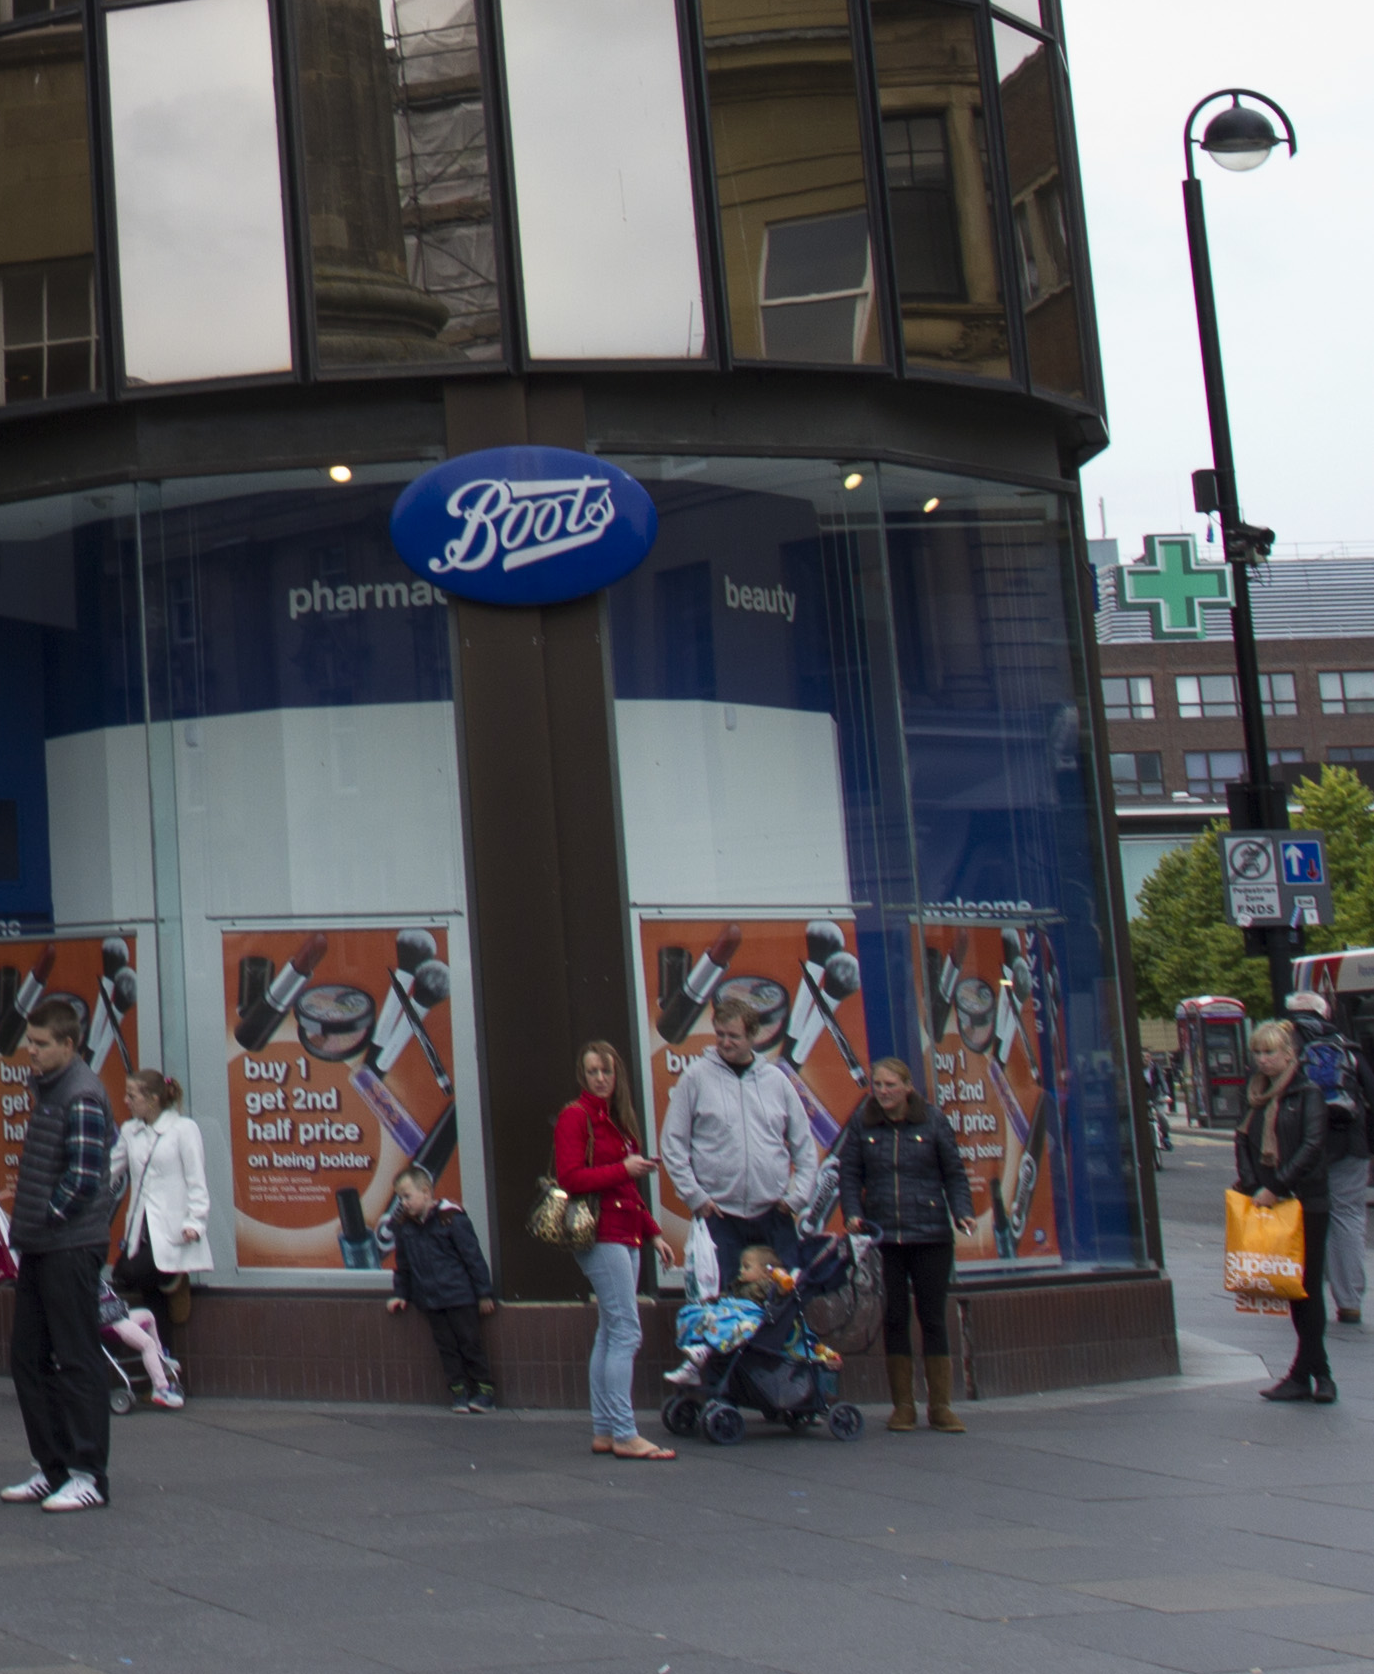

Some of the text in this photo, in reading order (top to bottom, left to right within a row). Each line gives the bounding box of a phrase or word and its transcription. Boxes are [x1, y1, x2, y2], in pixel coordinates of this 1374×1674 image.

[428, 475, 615, 573] Boots
[724, 574, 797, 623] beauty
[244, 1056, 308, 1084] buy 1
[958, 1049, 965, 1070] 1
[0, 1062, 31, 1086] buy
[2, 1091, 30, 1116] get
[245, 1086, 338, 1115] get 2nd
[937, 1078, 985, 1107] get 2nd
[3, 1119, 28, 1141] hal
[247, 1118, 361, 1146] half price
[963, 1109, 997, 1136] price
[4, 1154, 19, 1166] on
[248, 1151, 372, 1171] on being bolder
[976, 1142, 1004, 1158] bolder
